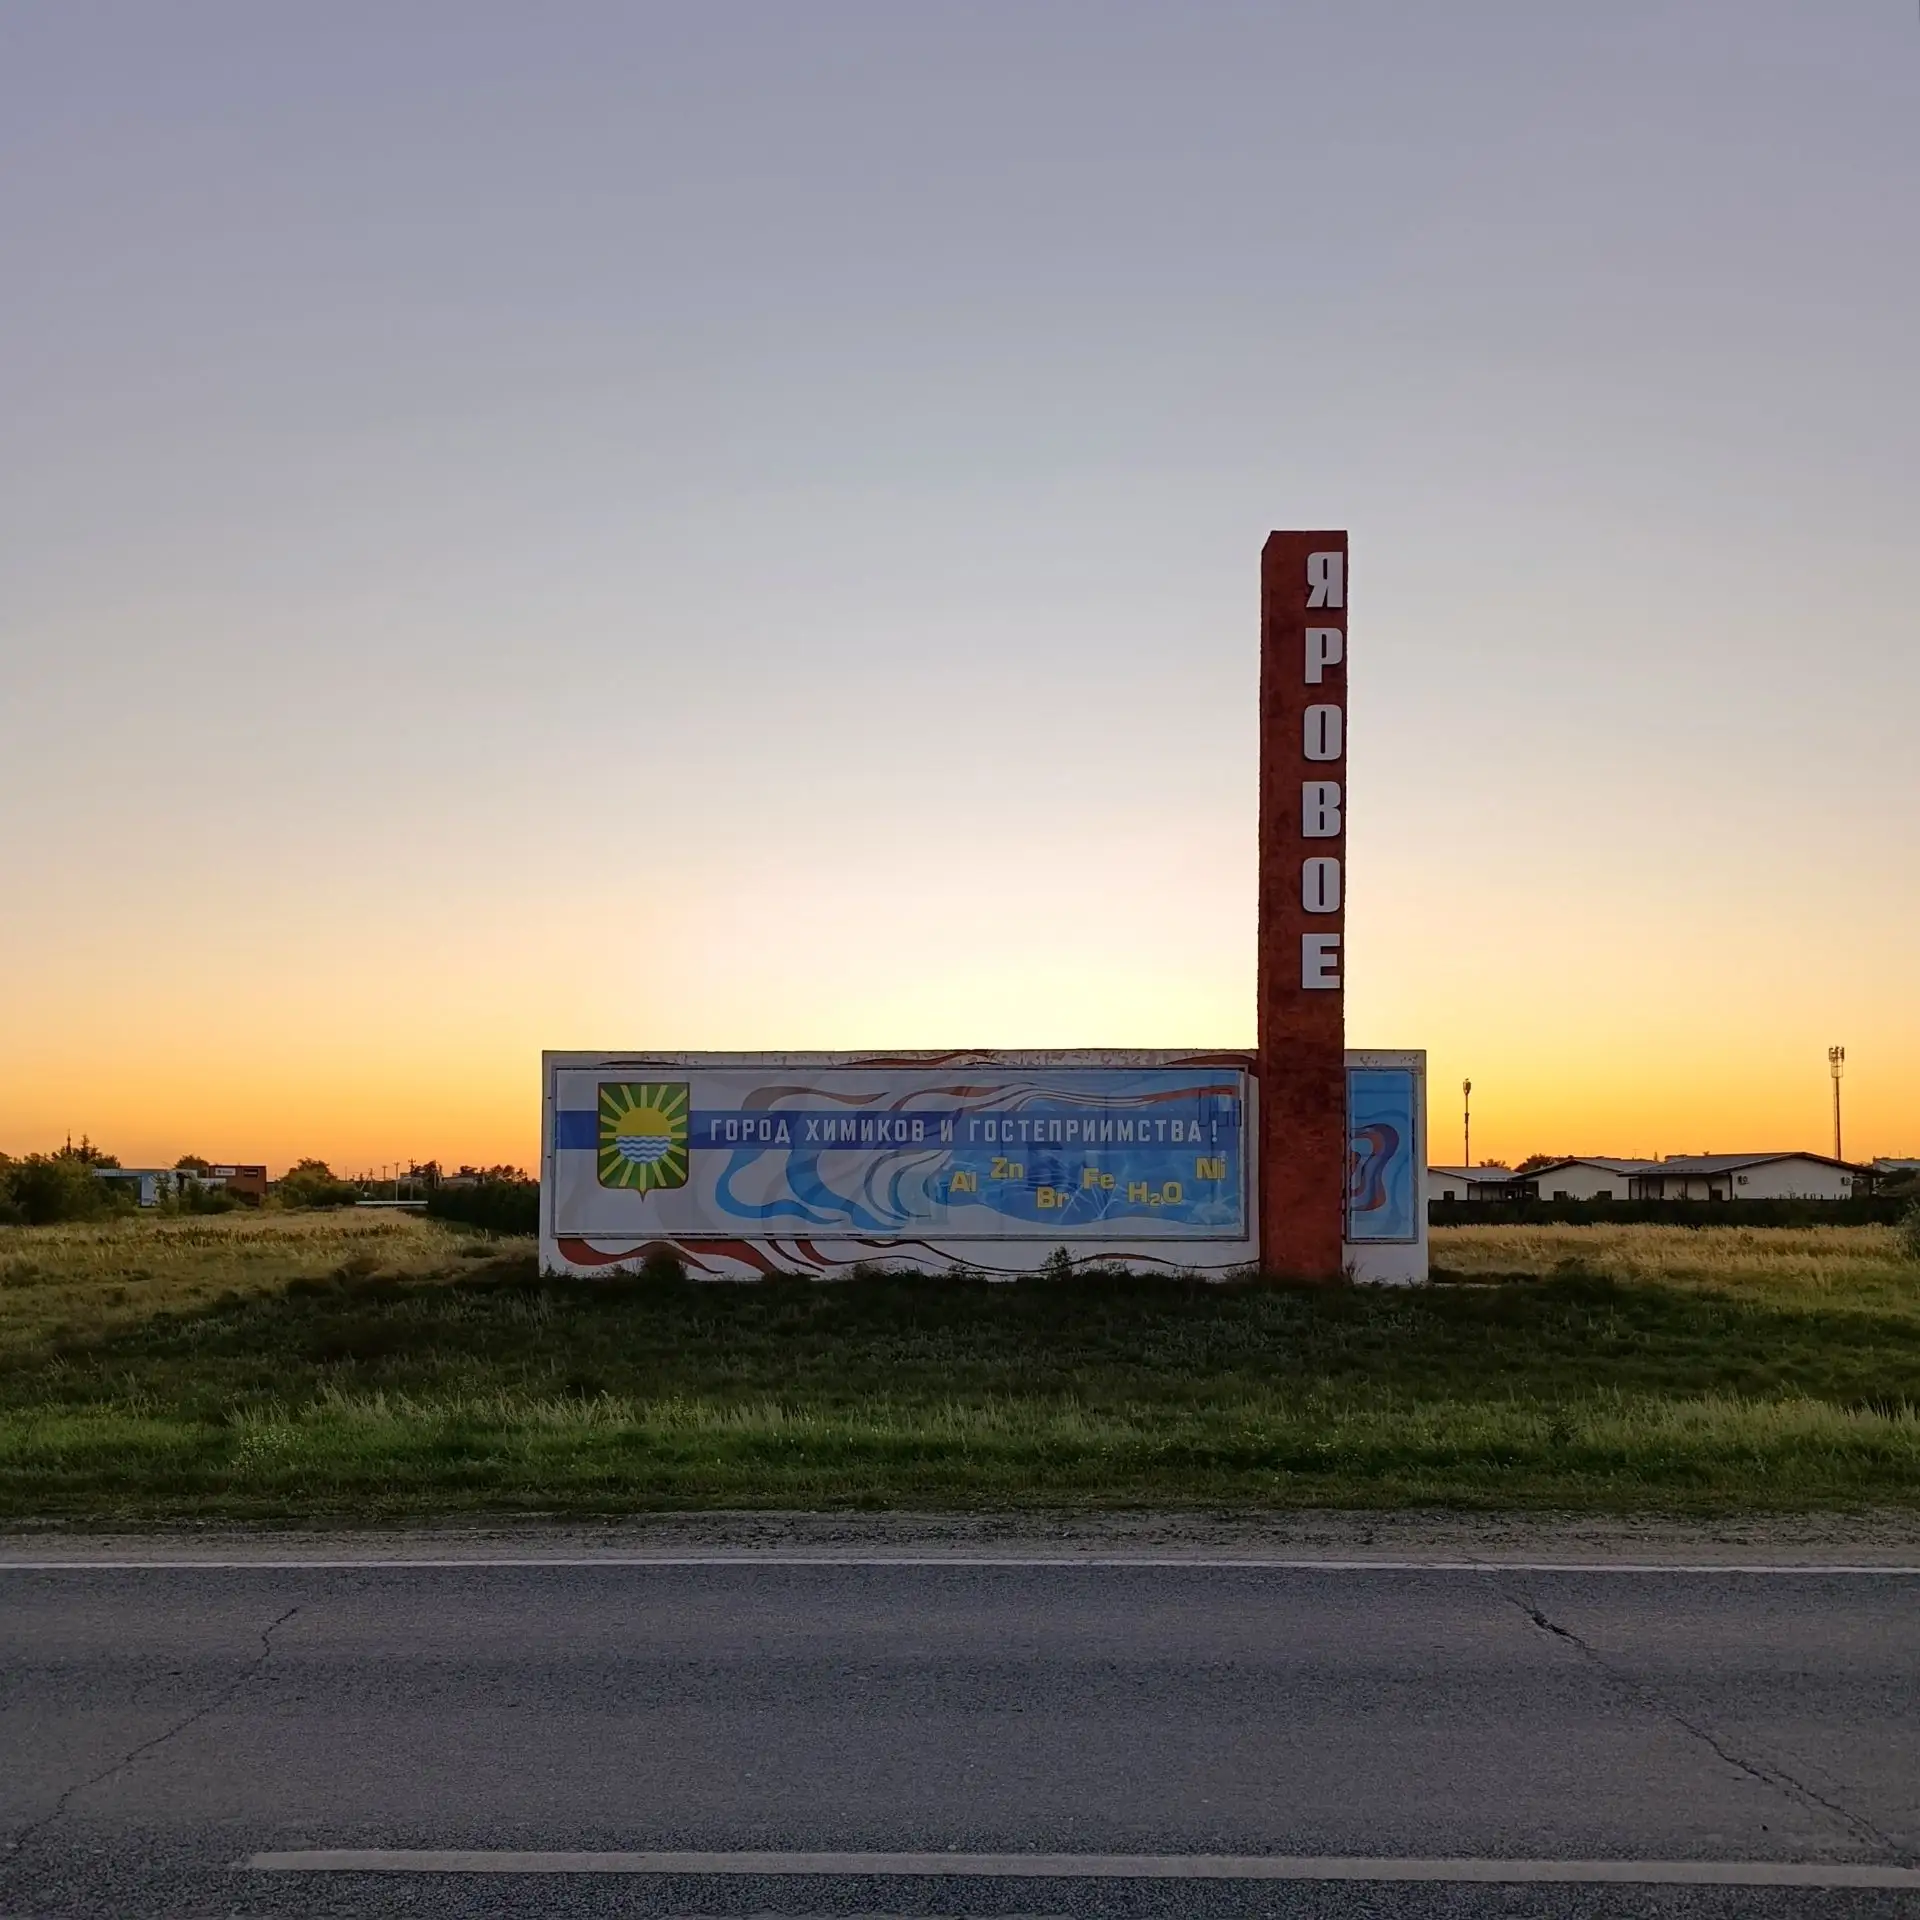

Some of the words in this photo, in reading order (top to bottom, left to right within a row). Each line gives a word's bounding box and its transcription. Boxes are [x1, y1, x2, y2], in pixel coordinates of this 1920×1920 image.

[1302, 551, 1343, 989] ЯРОВОЕ
[710, 1119, 790, 1143] ГОРОД
[805, 1119, 925, 1142] ХИМИКОВ
[940, 1119, 953, 1142] И
[969, 1119, 1202, 1143] ГОСТЕПРИИМСТВА
[990, 1157, 1024, 1179] Zn
[1083, 1167, 1115, 1189] Fe
[1195, 1157, 1226, 1179] Ni
[949, 1171, 977, 1192] Al
[1037, 1187, 1070, 1208] Br
